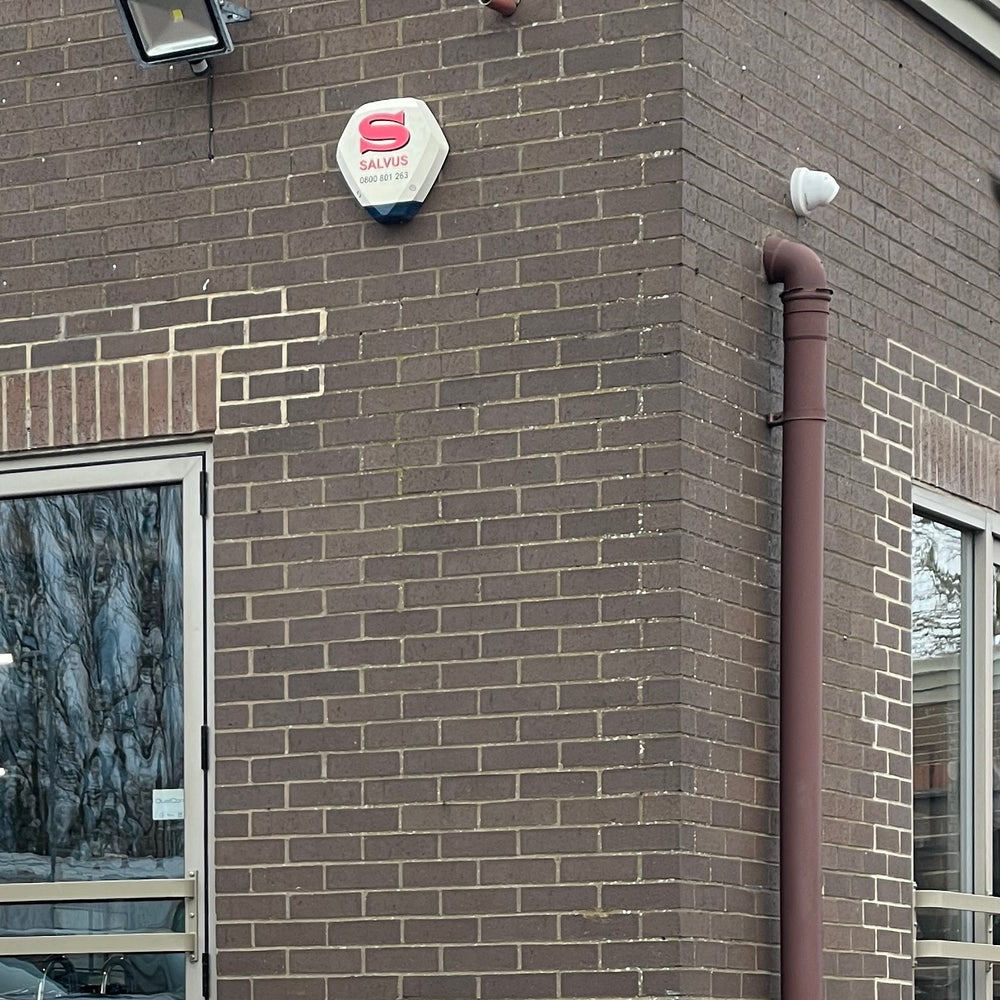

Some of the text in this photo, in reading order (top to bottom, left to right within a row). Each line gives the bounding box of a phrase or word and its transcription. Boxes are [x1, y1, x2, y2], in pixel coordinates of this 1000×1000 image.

[359, 155, 409, 171] SALVUS
[359, 171, 409, 184] 0800 801 263
